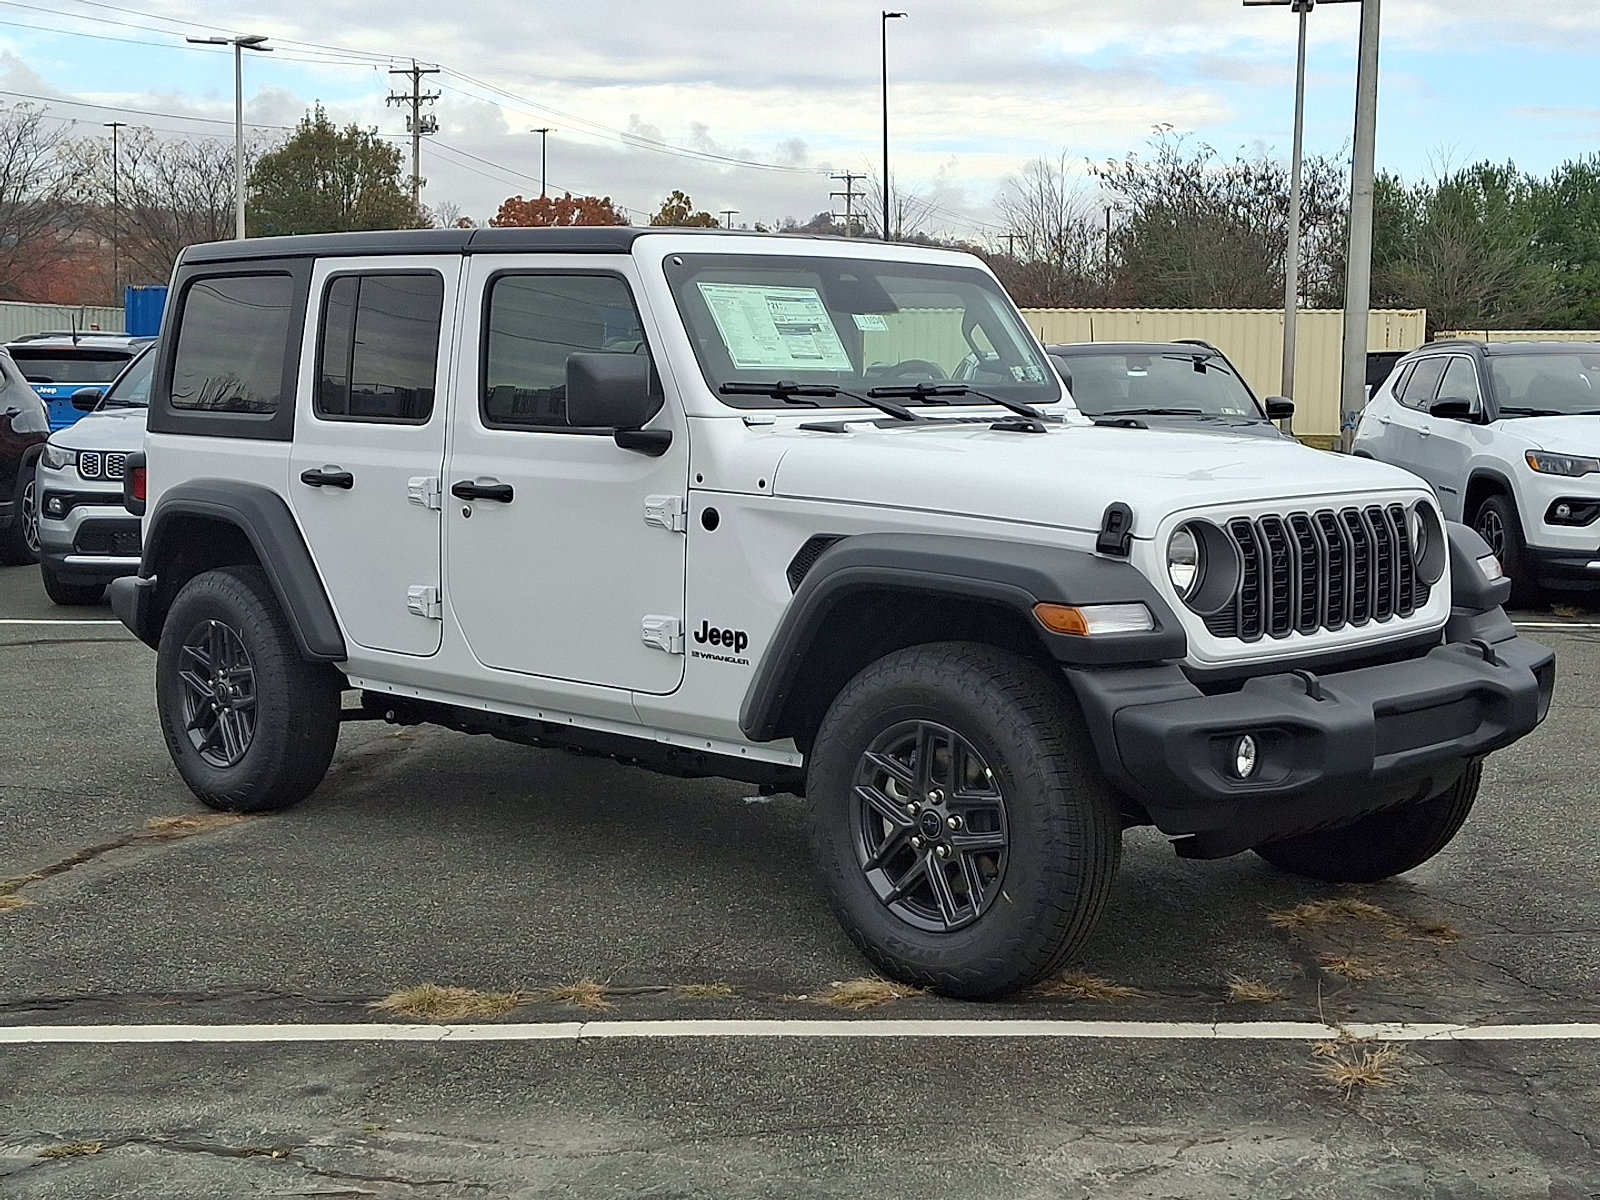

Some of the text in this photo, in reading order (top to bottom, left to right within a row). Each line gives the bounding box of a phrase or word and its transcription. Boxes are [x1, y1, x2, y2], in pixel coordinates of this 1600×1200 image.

[37, 386, 57, 395] Jeep
[693, 620, 749, 654] Jeep
[700, 652, 749, 666] WRANGLER
